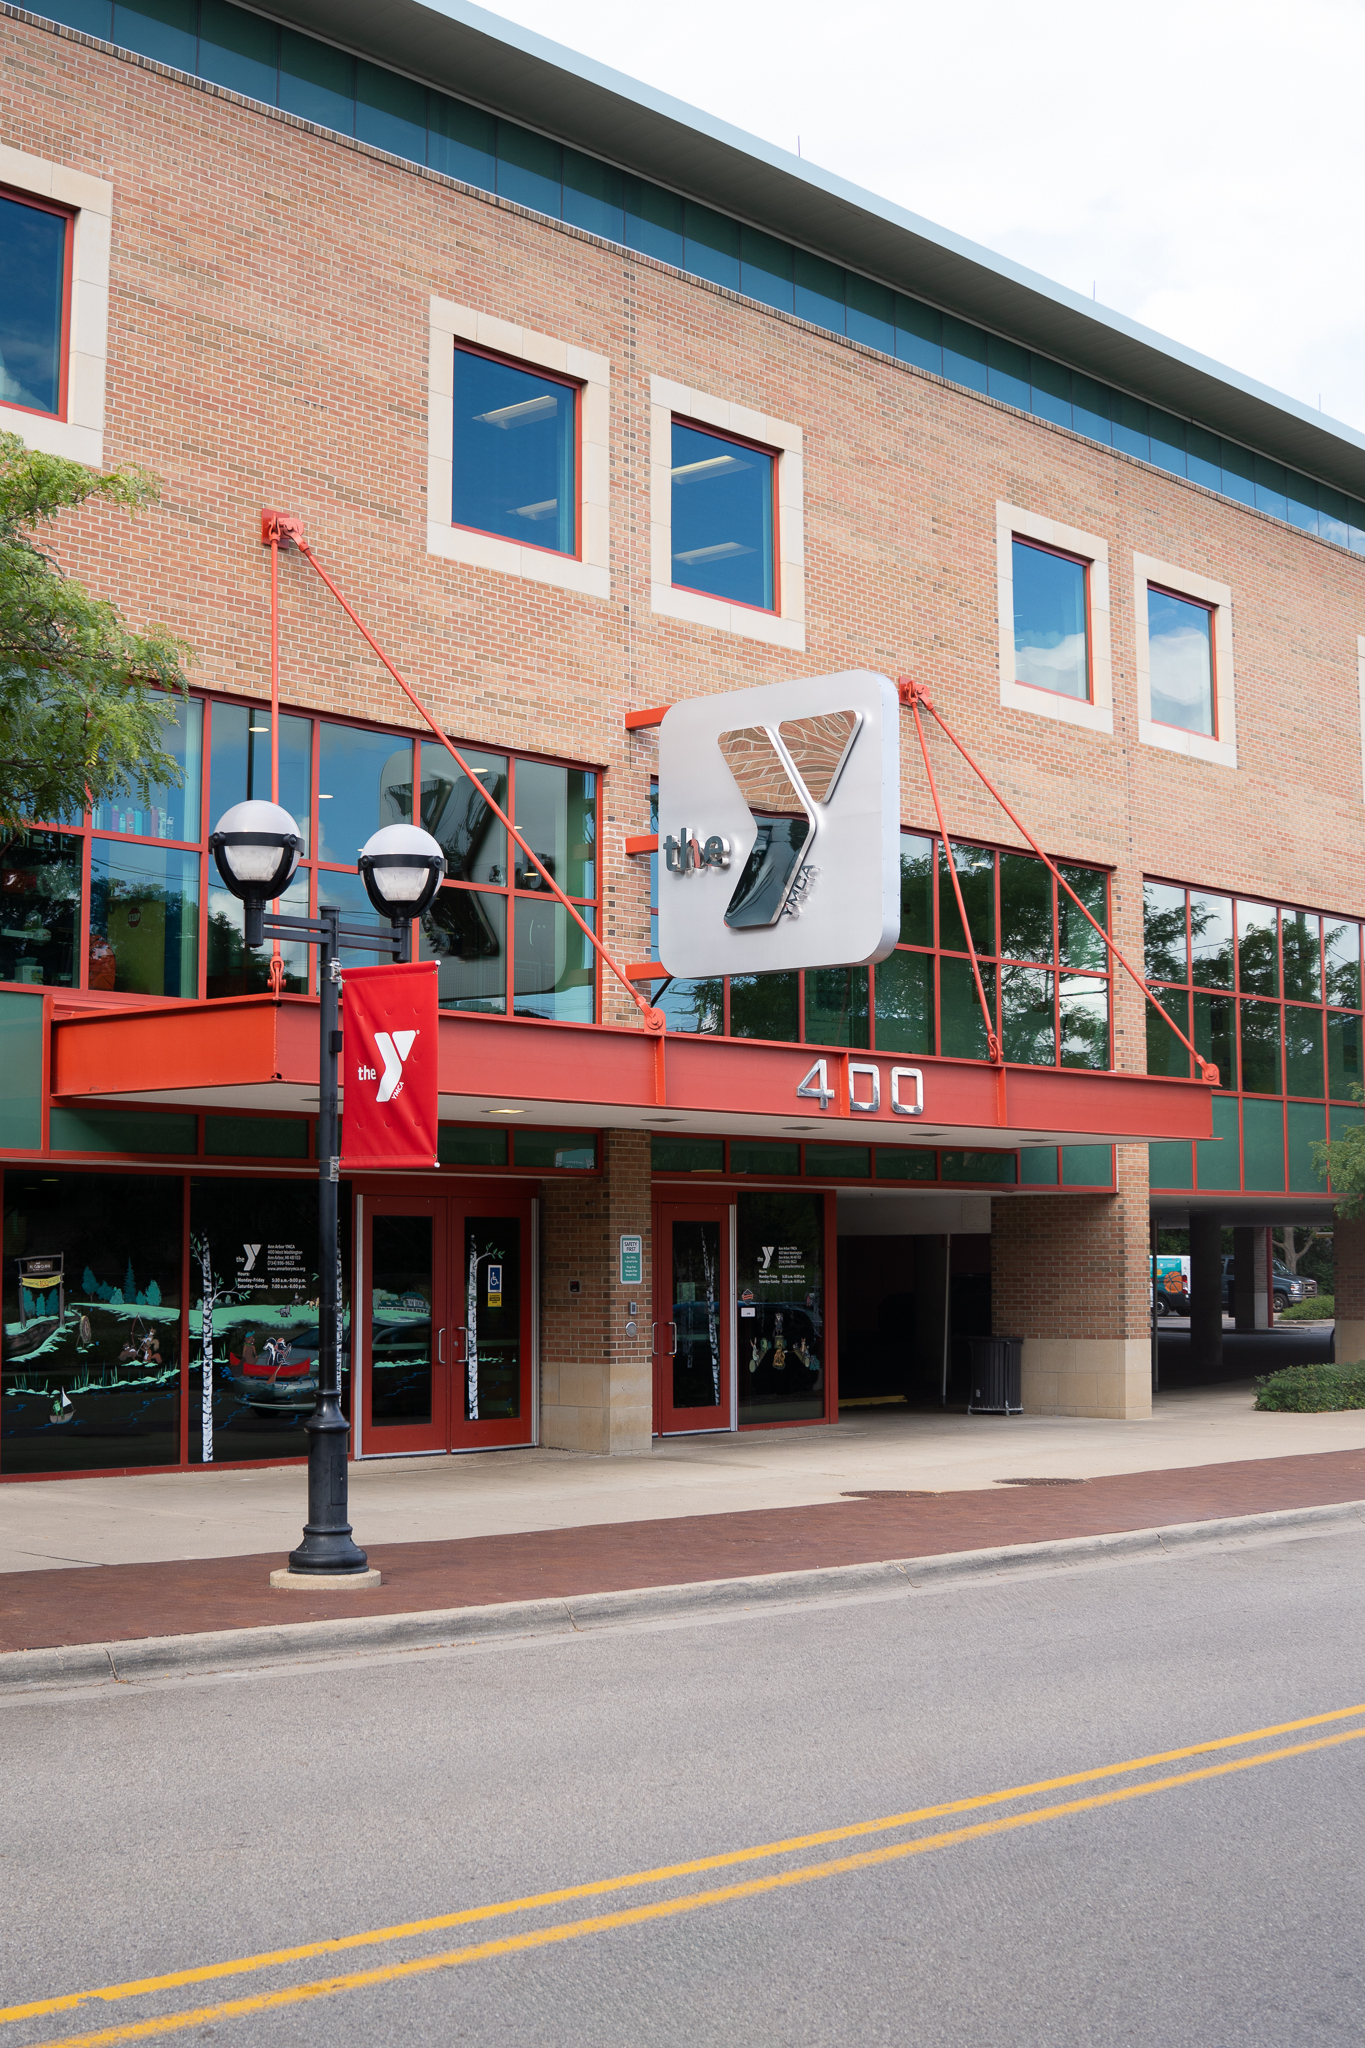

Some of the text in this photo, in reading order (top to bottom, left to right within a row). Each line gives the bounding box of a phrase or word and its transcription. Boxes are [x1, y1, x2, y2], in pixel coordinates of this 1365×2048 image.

[663, 827, 730, 872] the
[782, 864, 821, 916] YMCA
[357, 1065, 377, 1081] the
[391, 1081, 405, 1100] YMCA
[796, 1058, 924, 1115] 400
